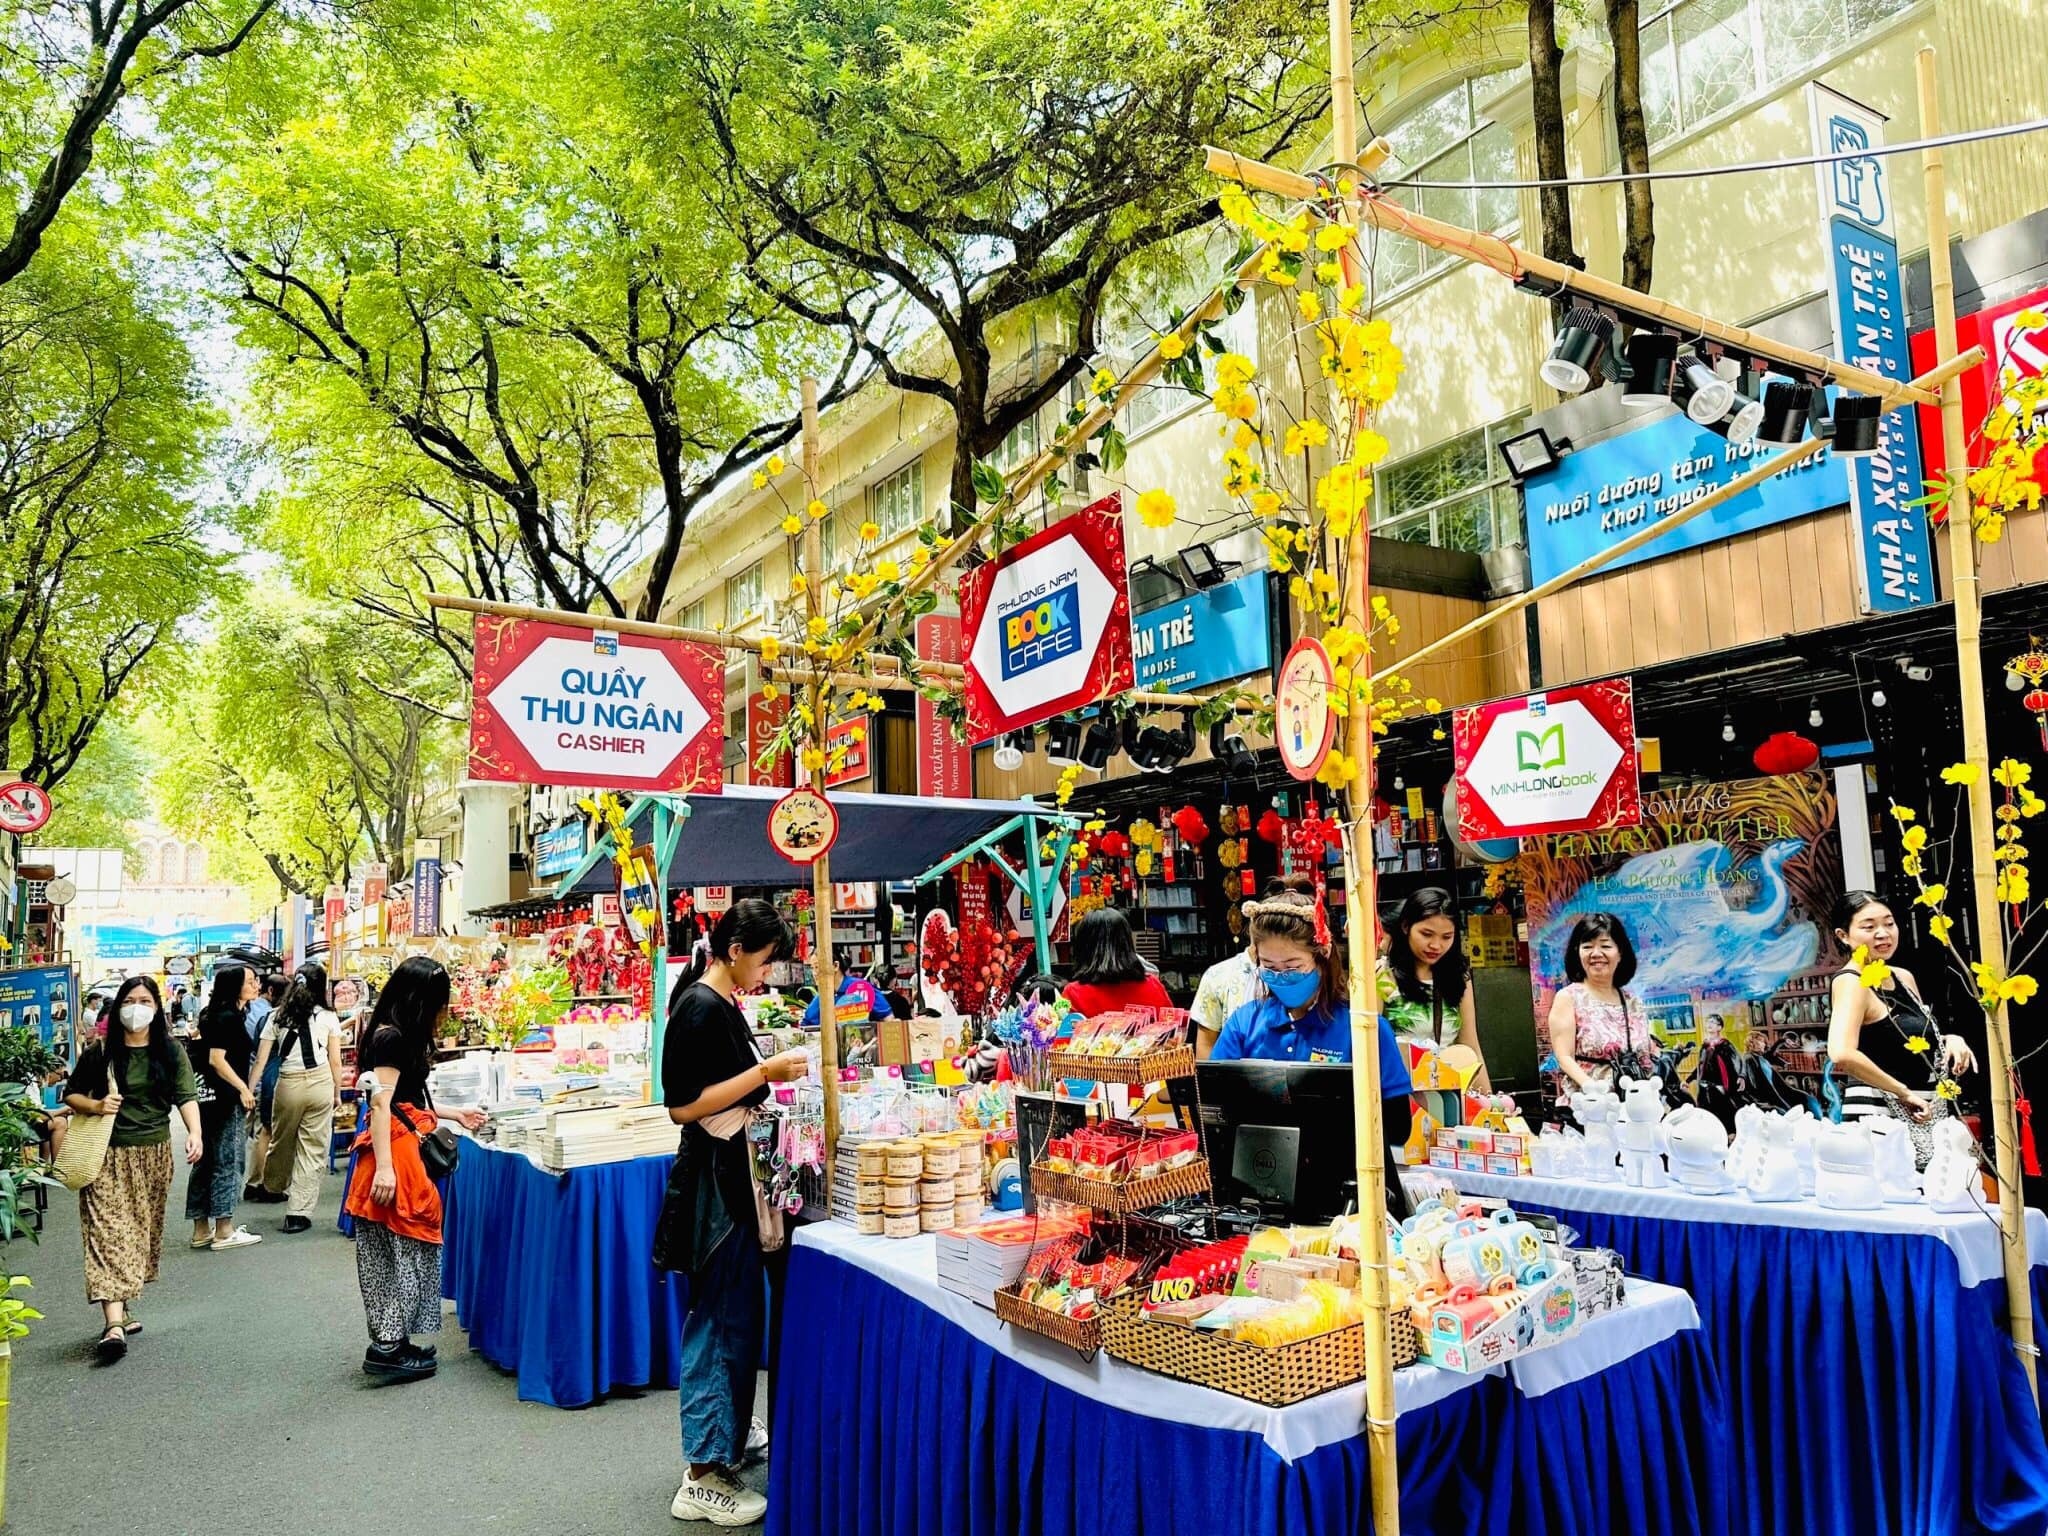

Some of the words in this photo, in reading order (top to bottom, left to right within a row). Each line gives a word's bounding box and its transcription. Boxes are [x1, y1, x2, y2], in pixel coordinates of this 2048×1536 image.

[1840, 243, 1876, 314] TRẺ
[1873, 250, 1894, 340] HOUSE
[1853, 324, 1882, 376] ẢN
[1884, 358, 1914, 531] PUBLISHG
[1545, 491, 1591, 522] Nuôi
[1598, 470, 1662, 505] dưỡng
[1671, 453, 1714, 483] tâm
[1601, 502, 1648, 531] Khơi
[1872, 519, 1906, 598] NHÀ
[1049, 568, 1079, 590] NAM
[1905, 551, 1921, 603] TRE
[930, 623, 942, 650] NAM
[1006, 593, 1071, 650] BOOK
[1132, 623, 1155, 659] ẢN
[1160, 604, 1195, 650] TRẺ
[1008, 627, 1073, 672] CAFE
[1142, 657, 1177, 678] HOUSE
[561, 666, 646, 699] QUẦY
[521, 696, 584, 725] THU
[594, 702, 683, 734] NGÂN
[557, 732, 645, 754] CASHIER
[930, 722, 944, 745] BẢN
[929, 745, 944, 777] XUẤT
[951, 755, 960, 791] Vietnam
[1491, 770, 1598, 797] MINHLONGbook
[1553, 828, 1653, 859] HARRY
[1665, 814, 1797, 848] POTTER
[837, 882, 877, 909] PN
[1150, 1277, 1194, 1303] UNO
[688, 1487, 740, 1513] BOSTON
